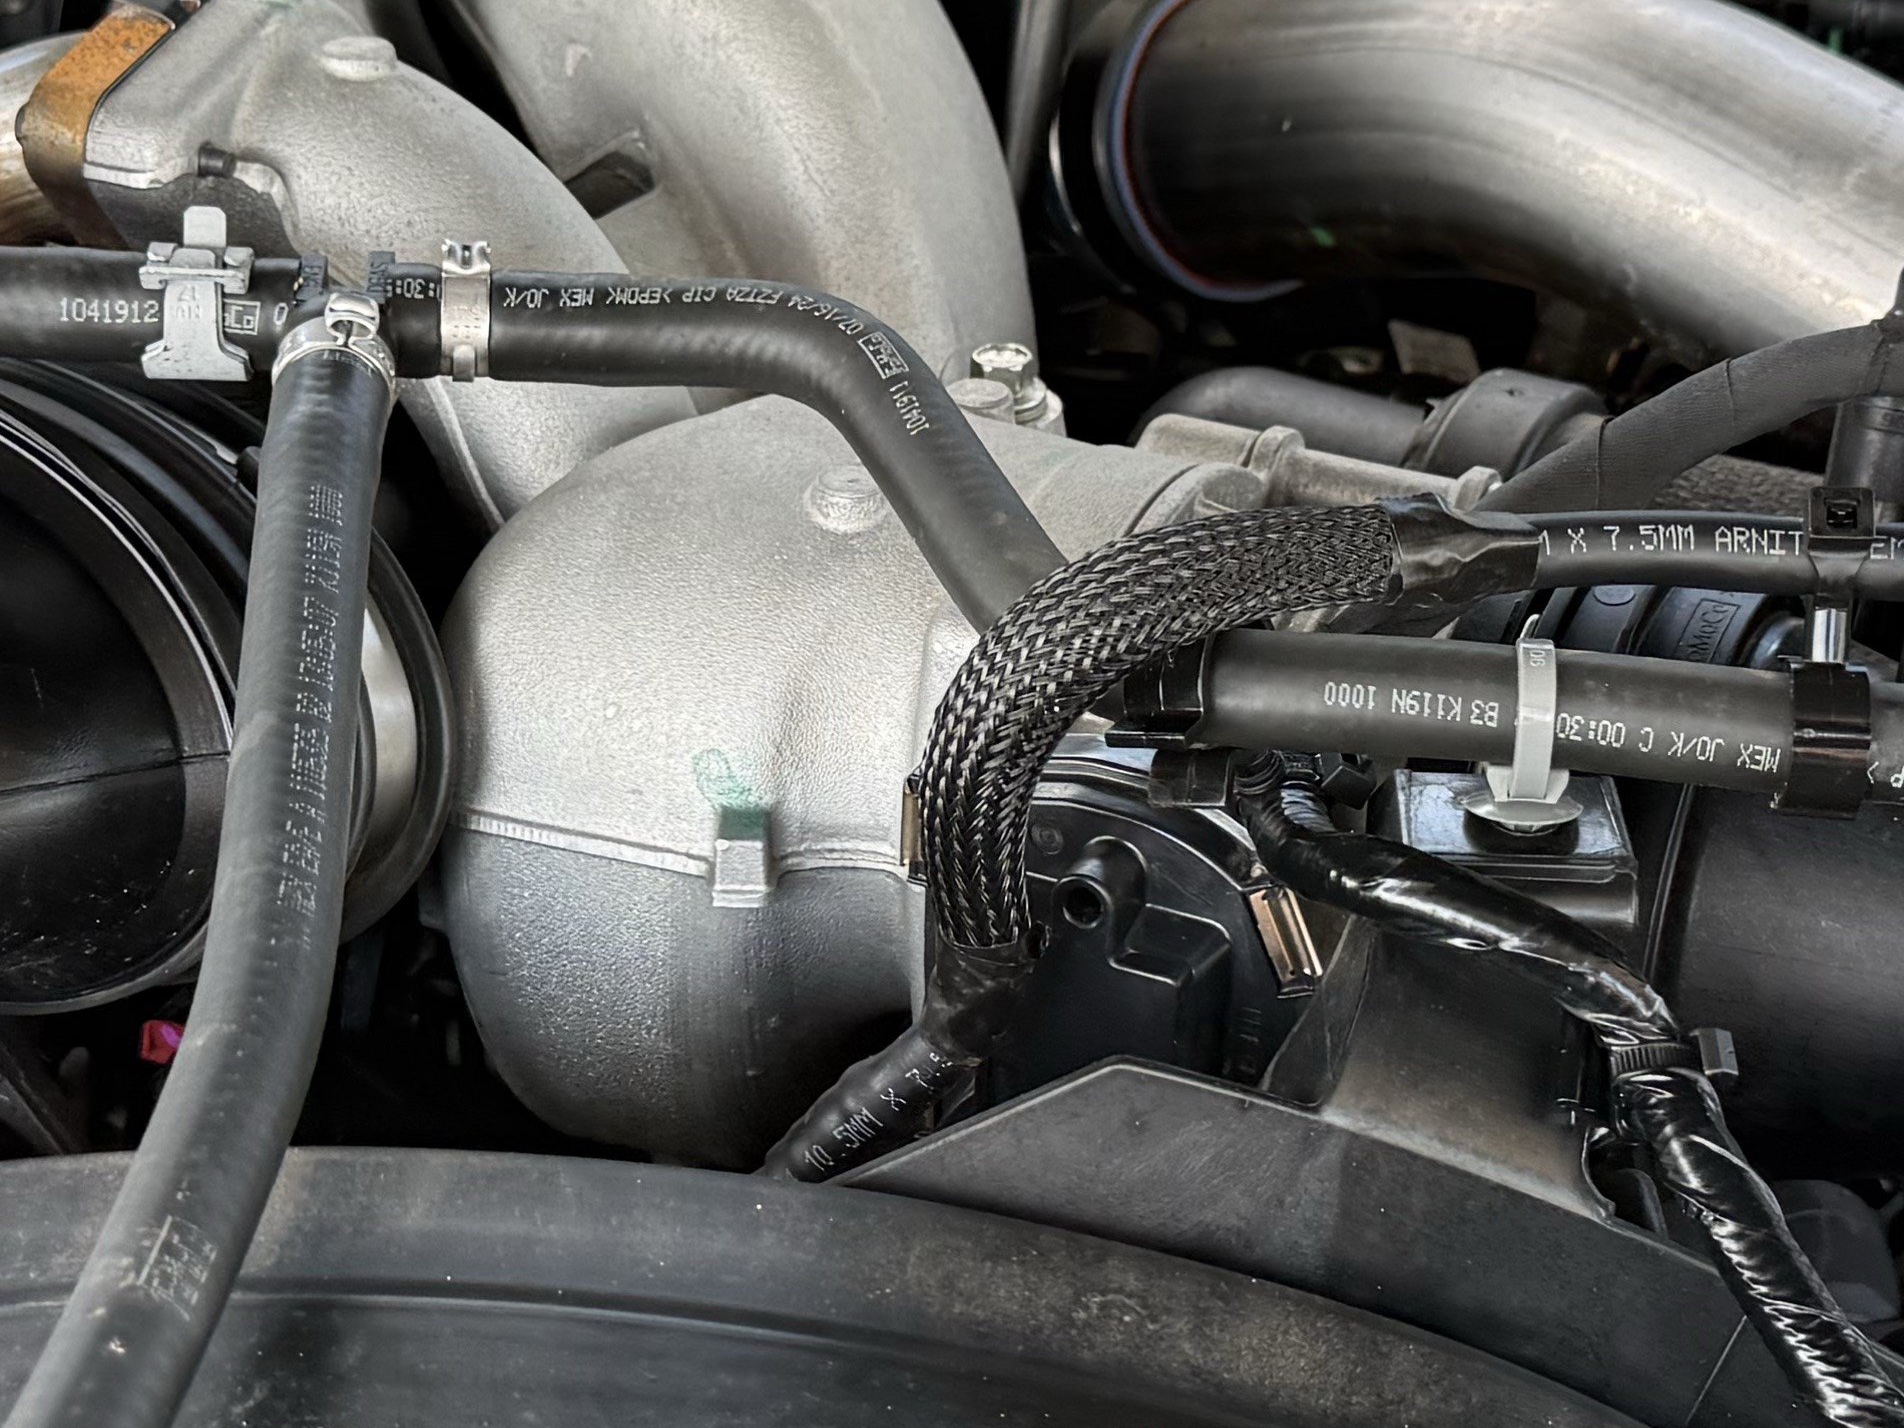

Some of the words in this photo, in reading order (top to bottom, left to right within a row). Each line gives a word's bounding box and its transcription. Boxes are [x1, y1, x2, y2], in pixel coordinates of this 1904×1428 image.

[59, 297, 160, 324] 1041912
[558, 286, 595, 308] MEX
[681, 286, 718, 305] CIP
[1568, 527, 1587, 553] X
[1603, 524, 1695, 552] 7.5MM
[1715, 527, 1804, 556] ARNIT
[1322, 679, 1376, 710] 1000
[1391, 686, 1462, 724] K119N
[1470, 697, 1500, 727] B3
[1639, 726, 1655, 753] C
[1738, 742, 1781, 773] MEX
